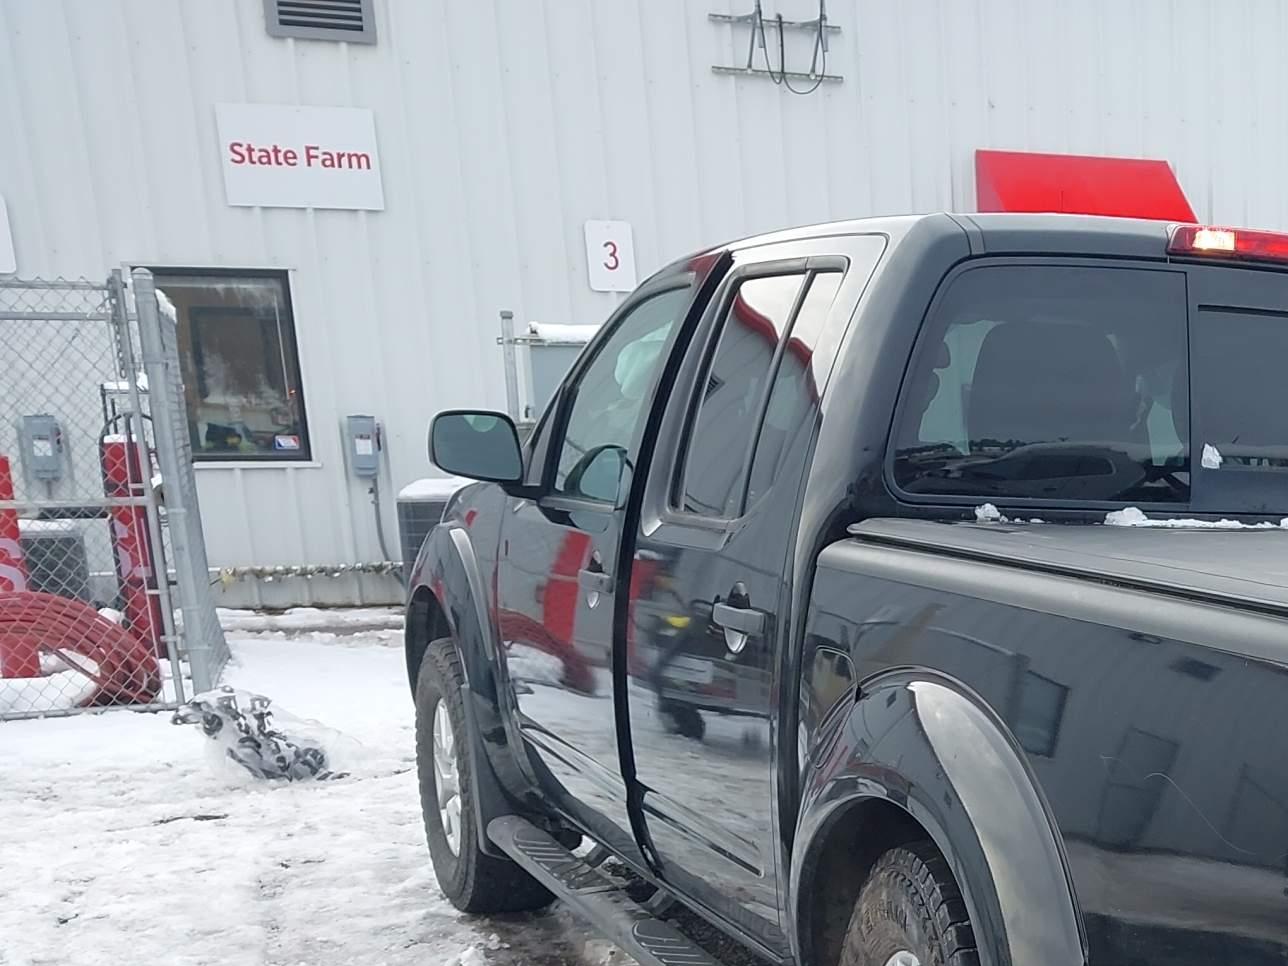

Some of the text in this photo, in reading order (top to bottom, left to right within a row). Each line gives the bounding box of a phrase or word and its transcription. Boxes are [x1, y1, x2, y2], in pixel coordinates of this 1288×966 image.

[229, 141, 371, 170] State Farm
[603, 241, 619, 270] 3
